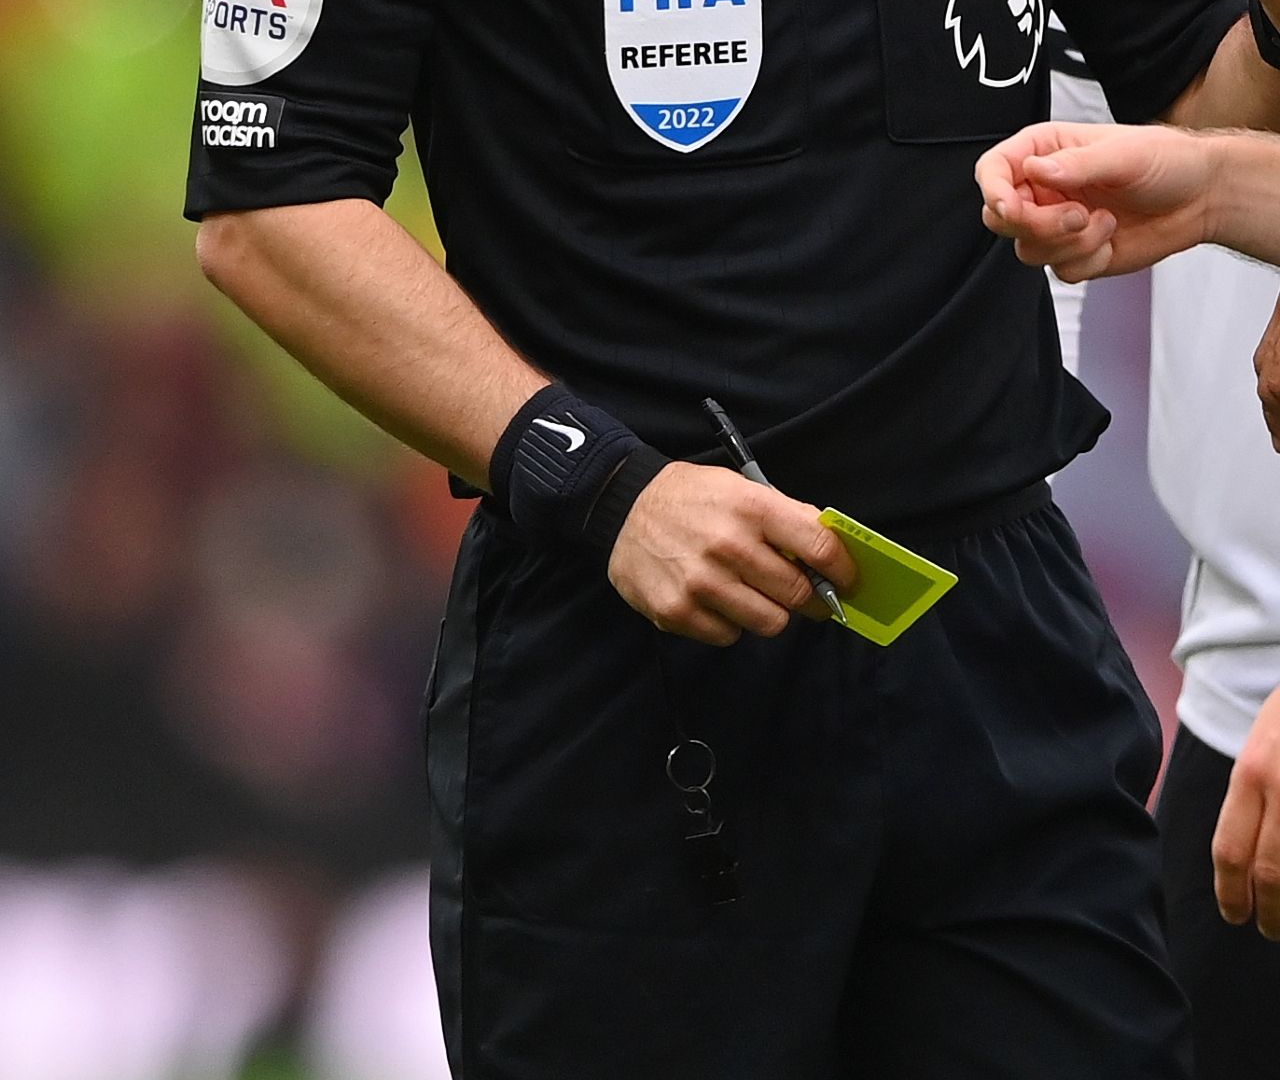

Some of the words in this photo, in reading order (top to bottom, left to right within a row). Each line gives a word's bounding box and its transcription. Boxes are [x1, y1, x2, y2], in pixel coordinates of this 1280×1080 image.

[620, 40, 748, 69] REFEREE
[201, 100, 267, 124] room
[658, 107, 715, 130] 2022
[202, 125, 275, 148] racism
